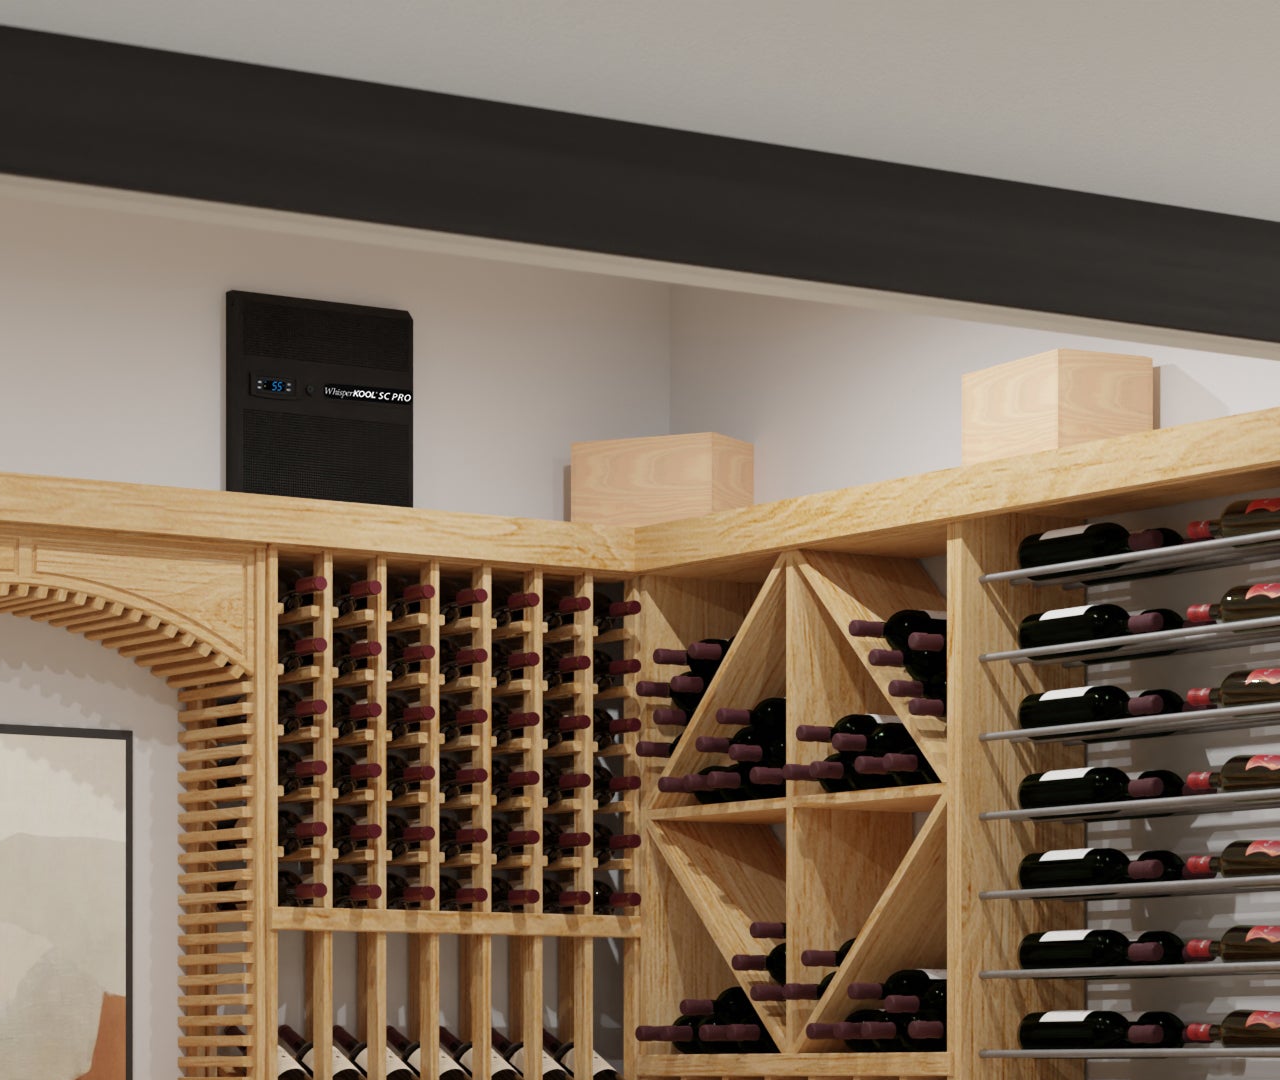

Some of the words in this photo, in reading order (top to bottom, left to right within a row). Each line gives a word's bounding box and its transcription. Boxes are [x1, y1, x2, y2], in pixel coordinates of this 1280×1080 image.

[271, 381, 283, 392] 55
[378, 391, 391, 401] SC
[391, 393, 412, 403] PRO
